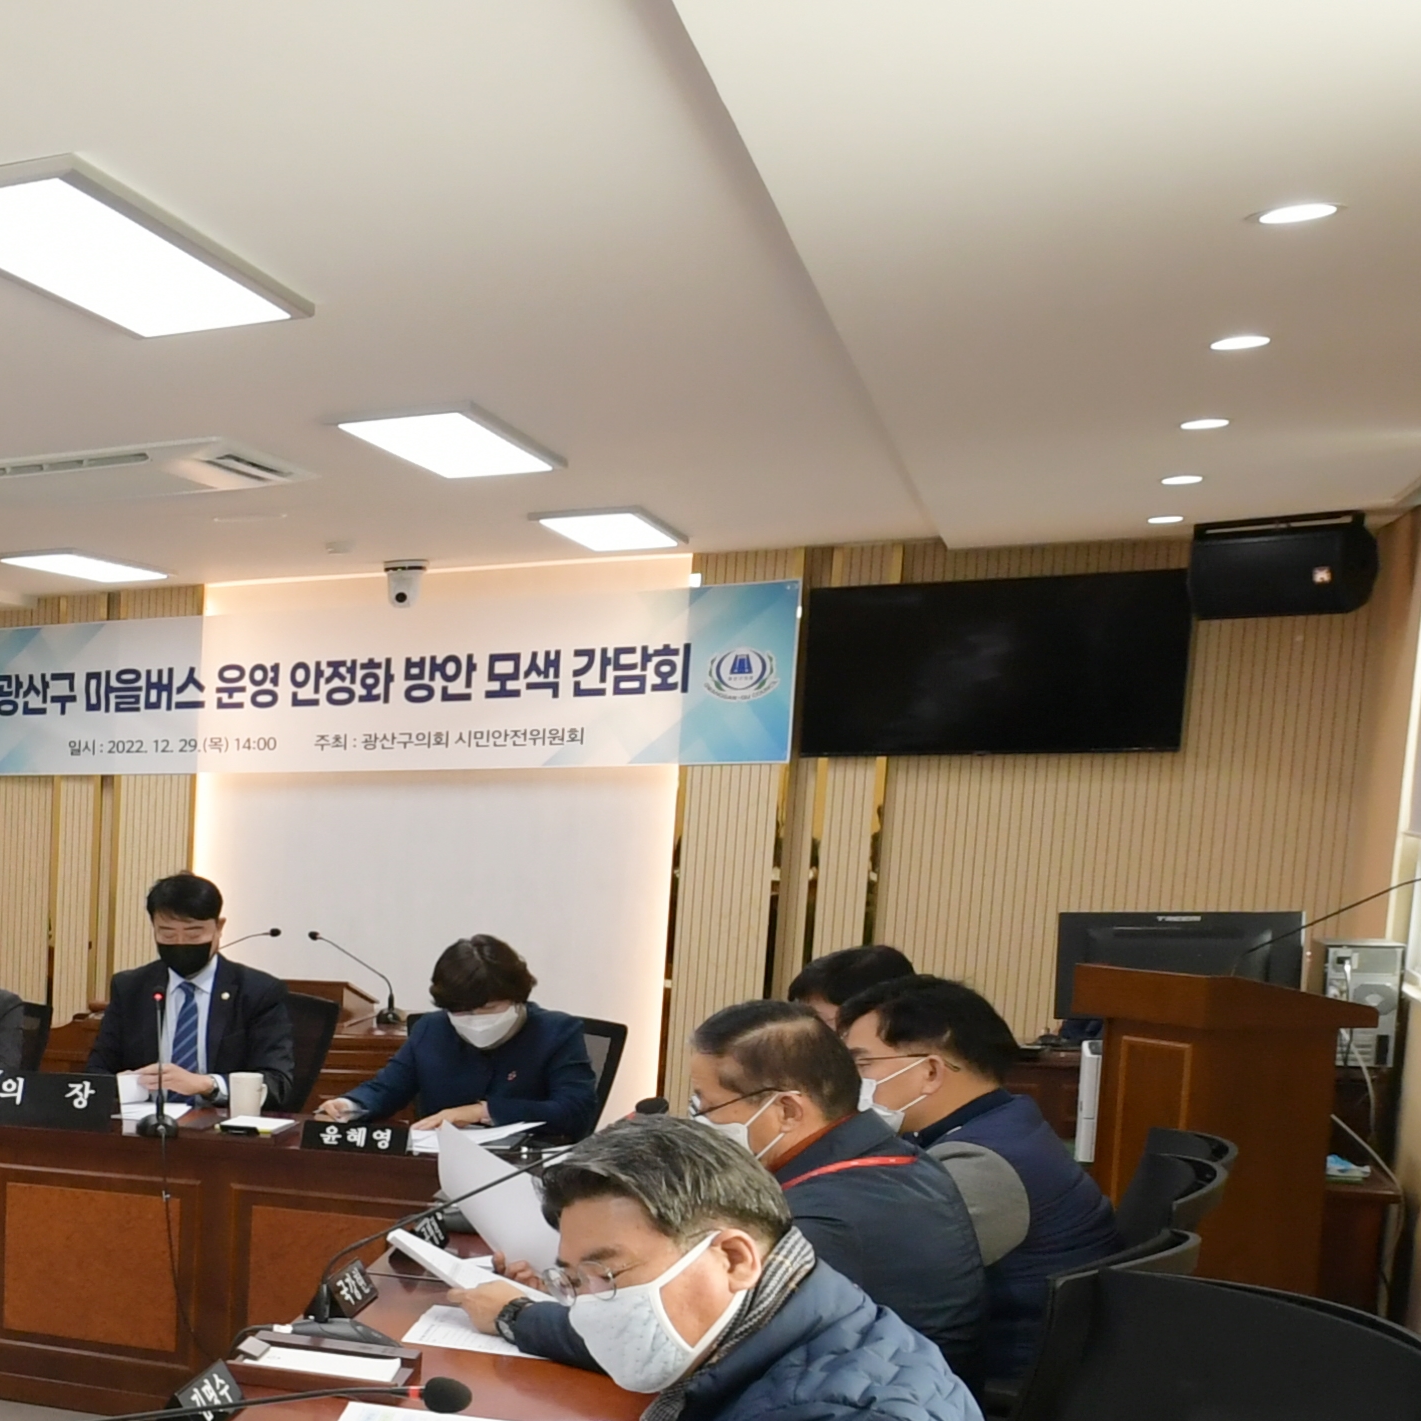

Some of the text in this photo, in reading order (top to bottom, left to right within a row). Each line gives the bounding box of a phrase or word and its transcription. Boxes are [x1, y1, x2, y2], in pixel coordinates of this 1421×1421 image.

[84, 666, 206, 714] 마을버스
[215, 662, 281, 709] 운영
[289, 657, 395, 707] 안정화
[403, 653, 477, 703] 방안
[484, 649, 560, 699] 모색
[571, 643, 692, 697] 간담회
[107, 739, 148, 754] 2022.
[152, 739, 174, 753] 12.
[234, 736, 277, 751] 14:00
[314, 733, 348, 751] 주최
[360, 730, 449, 750] 광산구의회
[454, 726, 585, 748] 시민안전위원회
[319, 1125, 392, 1149] 윤혜영
